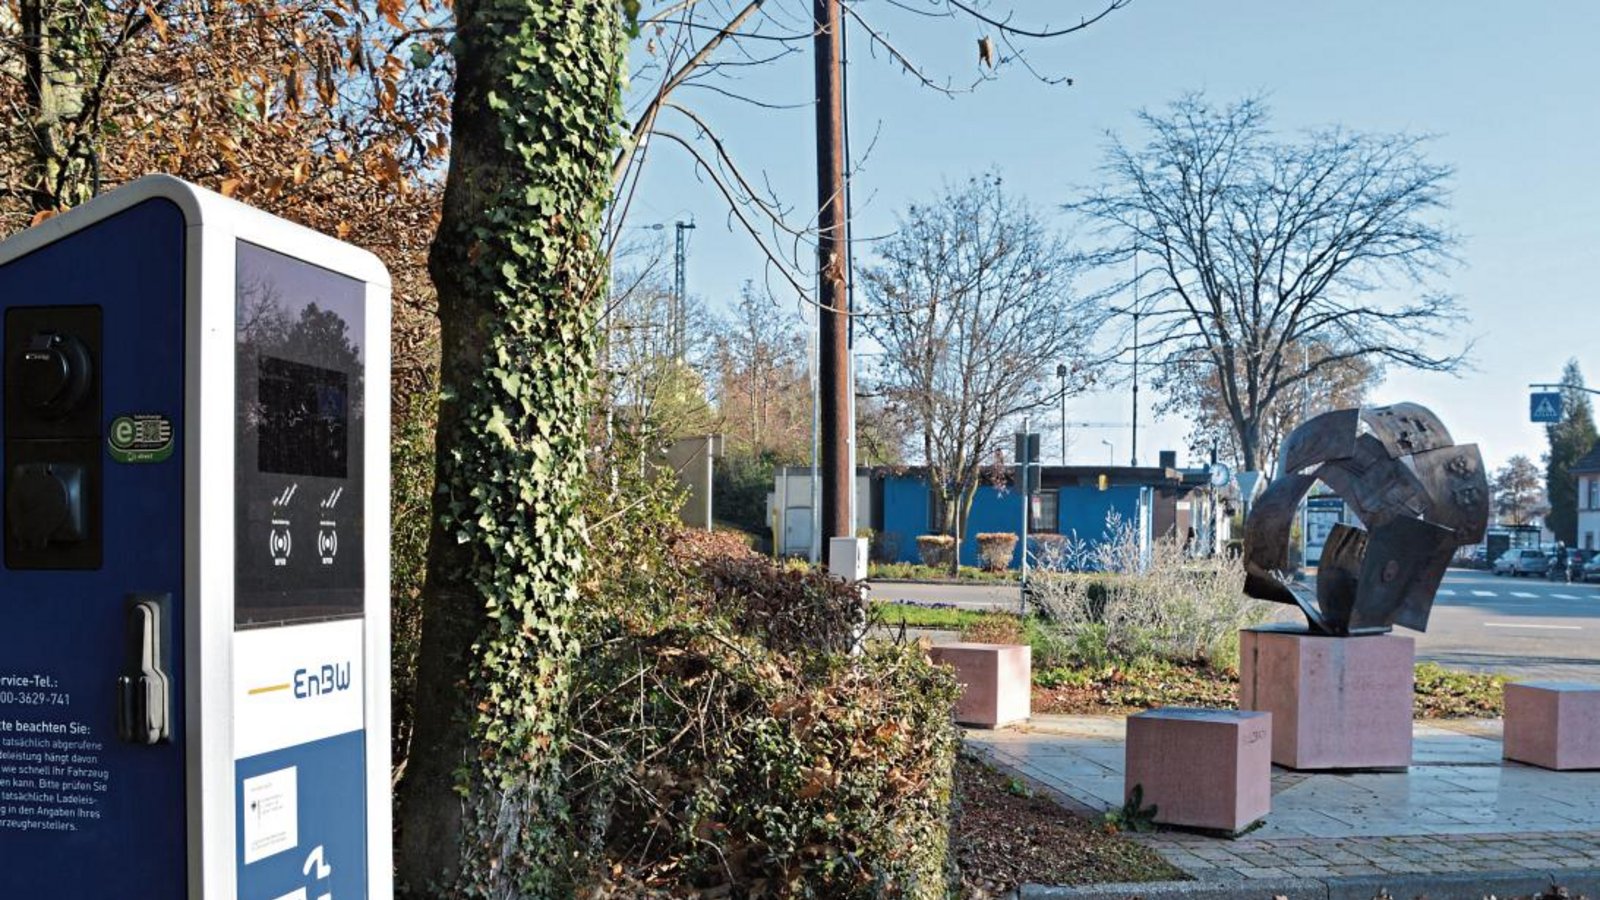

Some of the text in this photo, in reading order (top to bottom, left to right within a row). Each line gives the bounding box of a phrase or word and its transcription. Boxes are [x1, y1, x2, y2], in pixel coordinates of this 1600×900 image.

[294, 661, 351, 699] EnBW
[15, 720, 67, 733] beachten
[69, 721, 91, 735] Sie:
[71, 754, 98, 763] davon
[1, 765, 109, 780] wie schnell Ihr Fahrzeug
[39, 778, 60, 790] Bitte
[93, 781, 108, 792] Sie
[8, 804, 17, 814] in
[18, 804, 35, 815] den
[37, 806, 76, 818] Angaben
